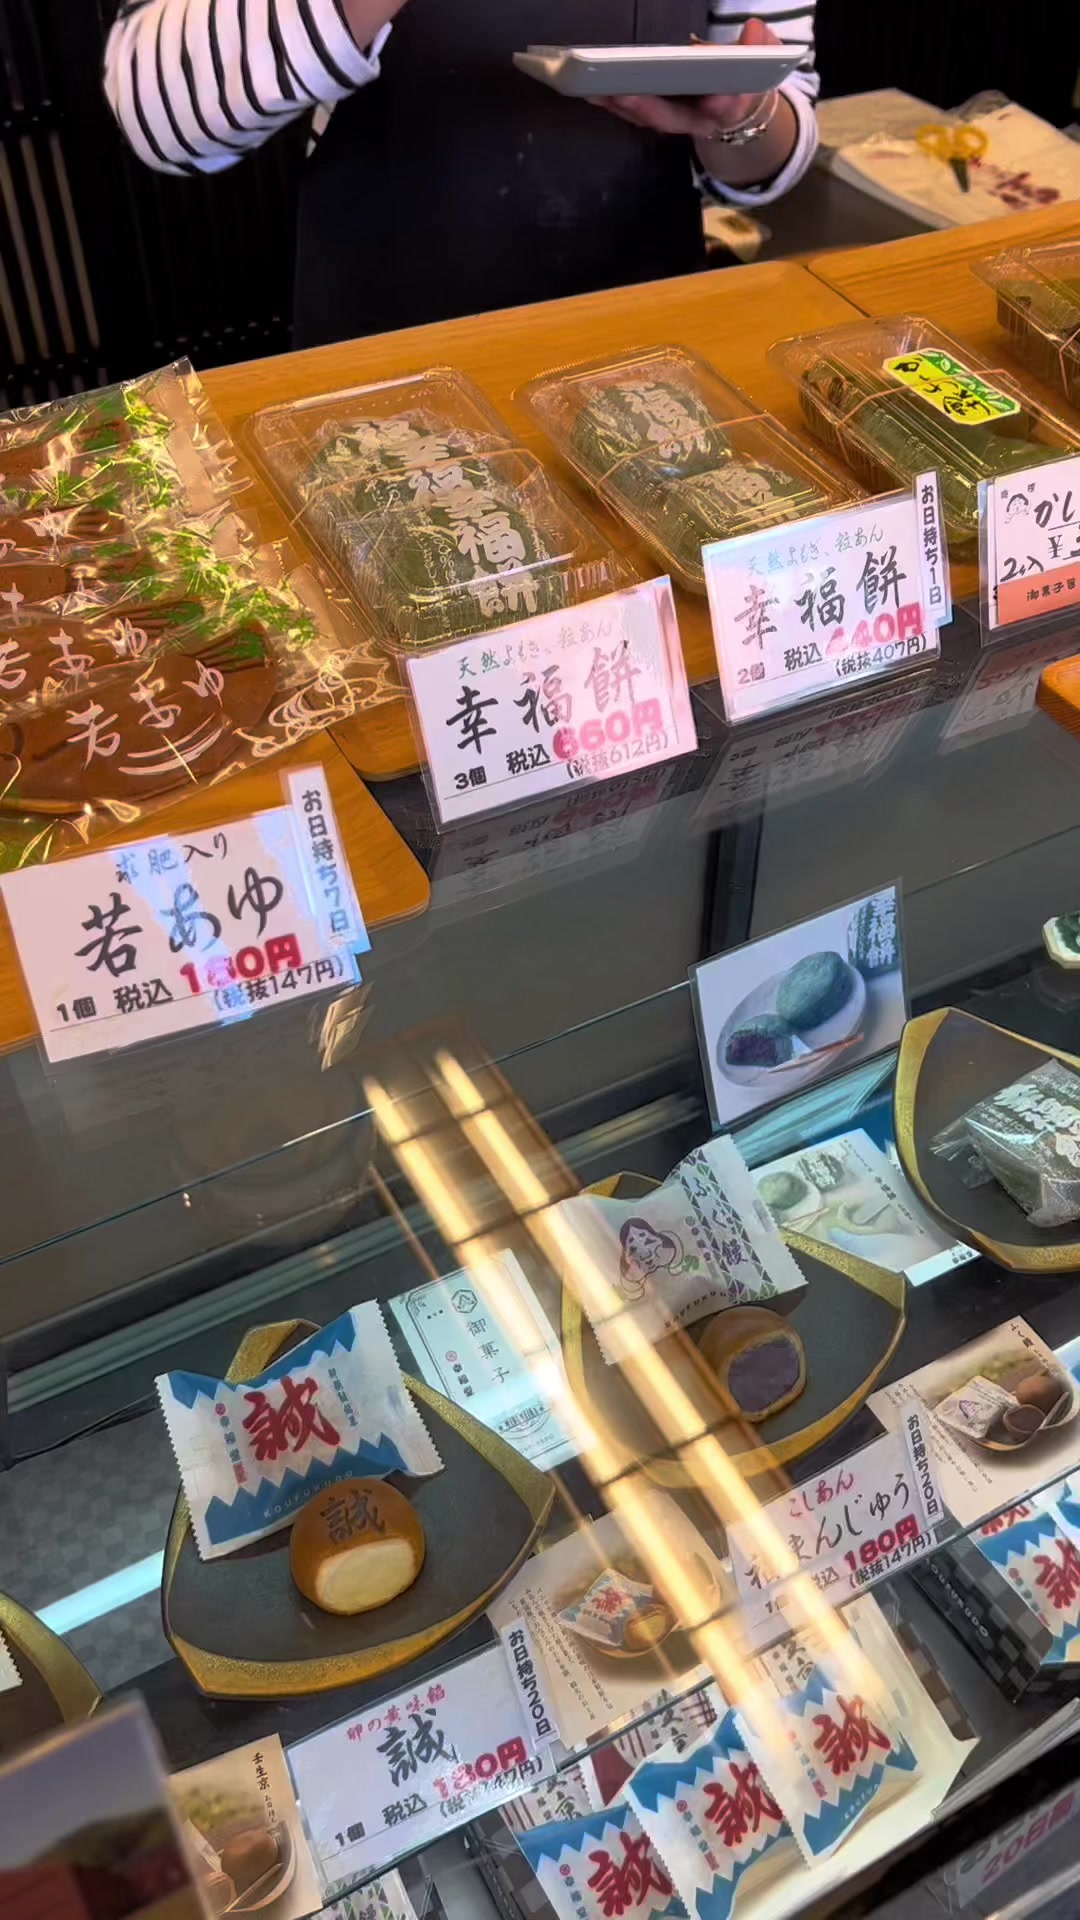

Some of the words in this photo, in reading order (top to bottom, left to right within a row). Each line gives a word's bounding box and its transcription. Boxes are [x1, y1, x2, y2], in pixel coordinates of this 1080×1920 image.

[920, 484, 943, 605] お日持ち1日
[733, 545, 908, 650] 幸福餅
[445, 639, 643, 755] 幸福餅
[783, 641, 824, 672] 税込
[835, 633, 928, 678] (税抜407円)
[453, 765, 488, 790] 3個
[505, 743, 551, 775] 税込
[552, 697, 665, 760] 660円
[300, 788, 350, 934] お日持ち7日
[74, 866, 285, 978] 若あゆ
[55, 995, 97, 1023] 1個
[112, 977, 173, 1015] 税込
[179, 933, 304, 994] 180円
[213, 953, 345, 1013] (税抜147円)
[465, 1317, 511, 1385] 御菓子
[242, 1375, 341, 1462] 誠
[789, 1467, 855, 1521] こしあん
[906, 1413, 940, 1516] お日持ち20日
[319, 1488, 387, 1545] 誠
[843, 1513, 921, 1572] 180円
[848, 1531, 934, 1589] (税抜147円)
[508, 1628, 552, 1737] お日持ち20日
[376, 1707, 461, 1788] 誠
[812, 1694, 892, 1776] 誠
[335, 1821, 367, 1847] 1個
[381, 1793, 428, 1828] 税込
[432, 1736, 529, 1801] 180円
[703, 1760, 784, 1848] 誠
[587, 1830, 674, 1918] 誠
